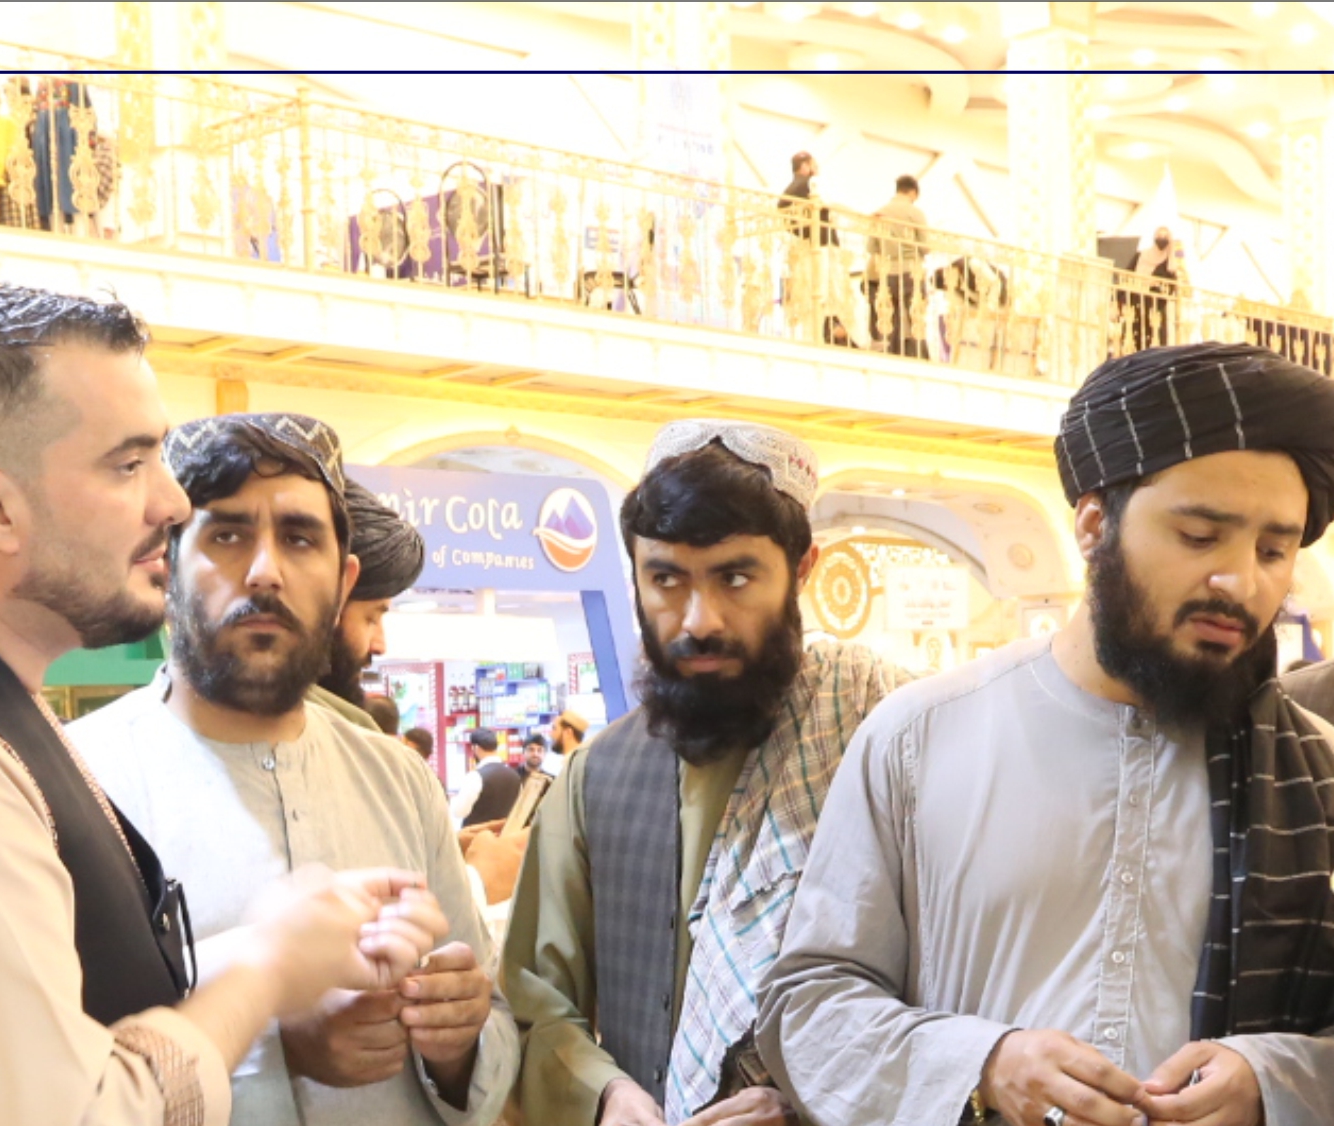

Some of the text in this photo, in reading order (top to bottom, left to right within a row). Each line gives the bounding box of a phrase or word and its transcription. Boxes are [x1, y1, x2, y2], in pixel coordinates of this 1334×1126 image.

[445, 495, 523, 540] Cola
[432, 545, 535, 571] of Companies
